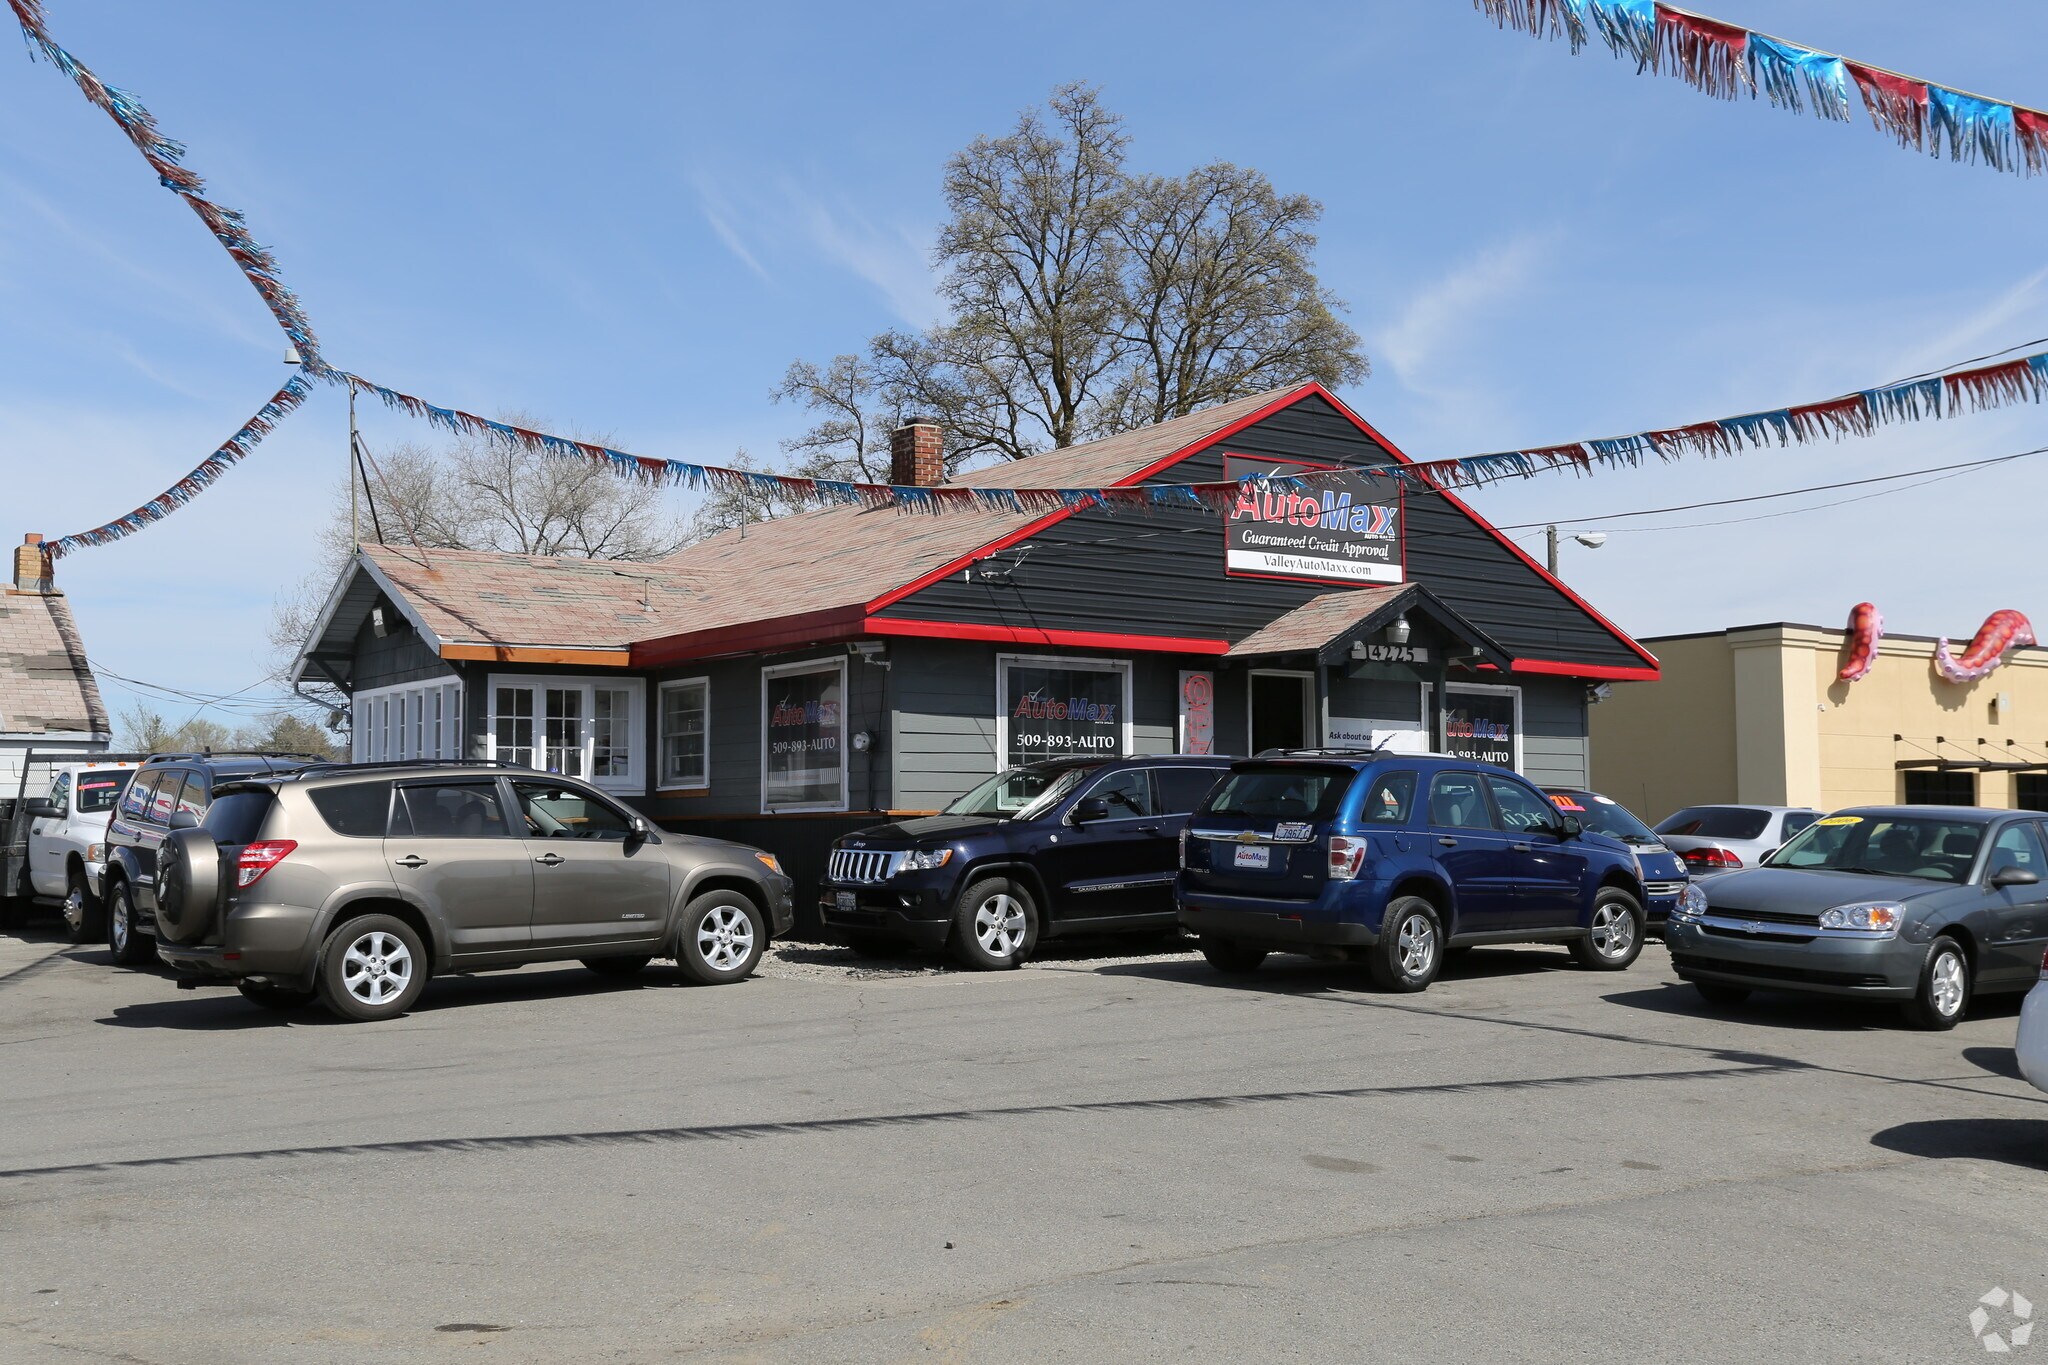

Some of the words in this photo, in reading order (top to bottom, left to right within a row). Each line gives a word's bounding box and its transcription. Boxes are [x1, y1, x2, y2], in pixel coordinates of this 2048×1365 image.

[1242, 530, 1306, 549] Guaranteed
[1308, 536, 1339, 552] Credit
[1342, 541, 1389, 559] Approval
[1264, 555, 1372, 576] ValleyAutoMaxx.com
[772, 736, 836, 754] 509-893-AUTO
[1016, 733, 1115, 748] 509-893-AUTO
[1329, 731, 1341, 740] Ask
[1342, 732, 1361, 741] about
